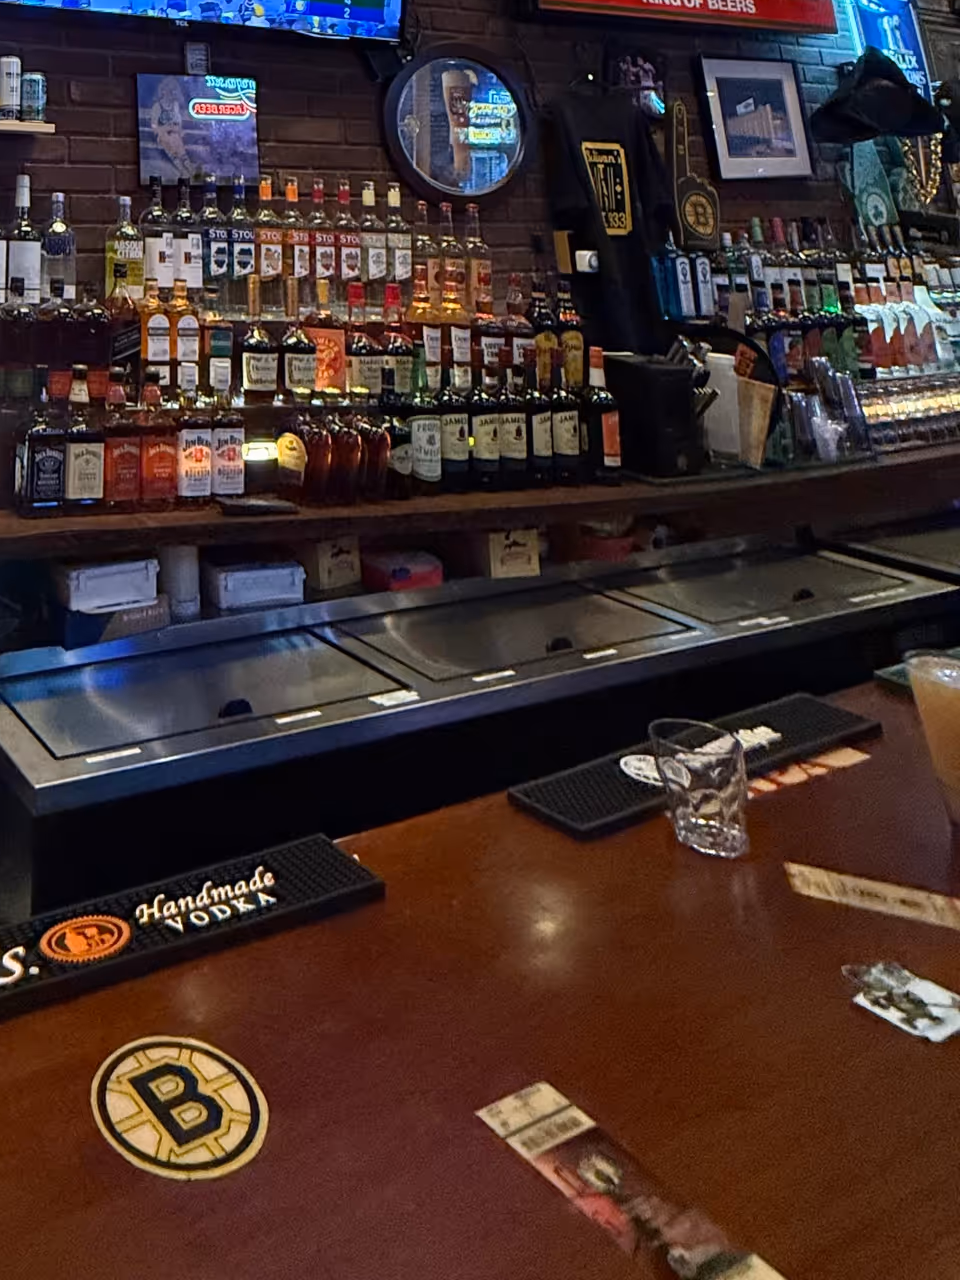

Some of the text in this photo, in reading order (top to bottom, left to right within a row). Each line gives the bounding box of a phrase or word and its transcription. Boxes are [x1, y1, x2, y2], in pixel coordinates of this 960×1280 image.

[344, 7, 351, 19] 2
[135, 866, 276, 924] Handmade
[165, 891, 278, 936] VODKA
[128, 1063, 224, 1146] B
